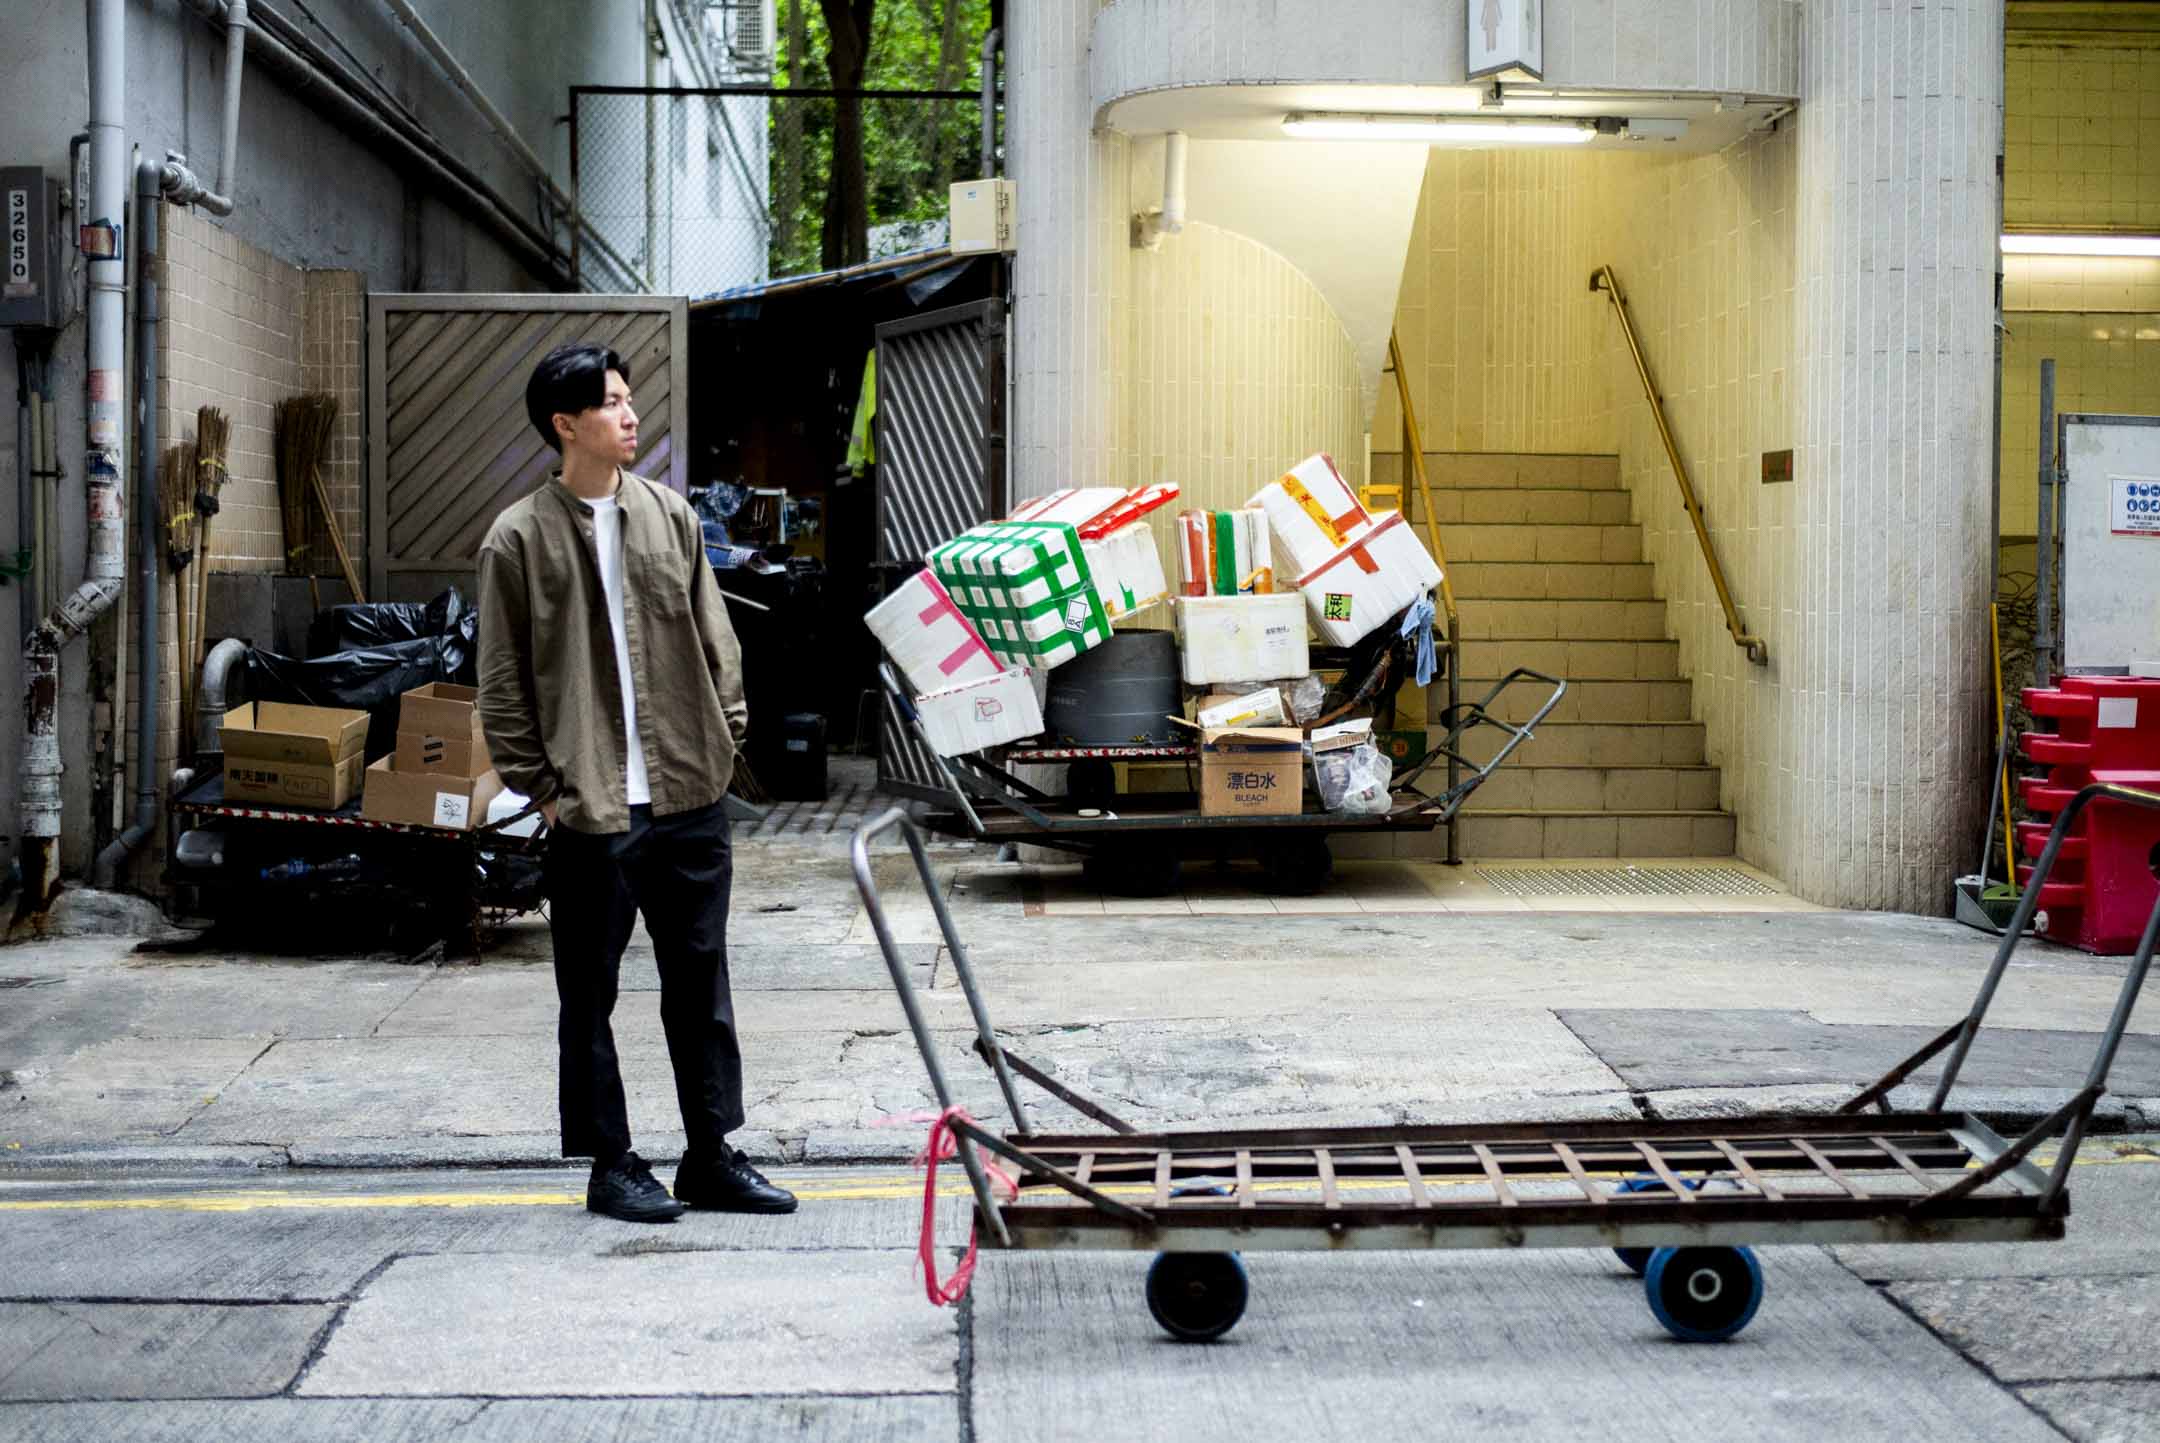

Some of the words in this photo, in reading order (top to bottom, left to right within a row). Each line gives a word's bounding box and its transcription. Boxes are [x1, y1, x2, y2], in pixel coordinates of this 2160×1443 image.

[12, 194, 26, 277] 32650
[1227, 772, 1277, 790] 漂白水
[1235, 793, 1268, 802] BLEACH
